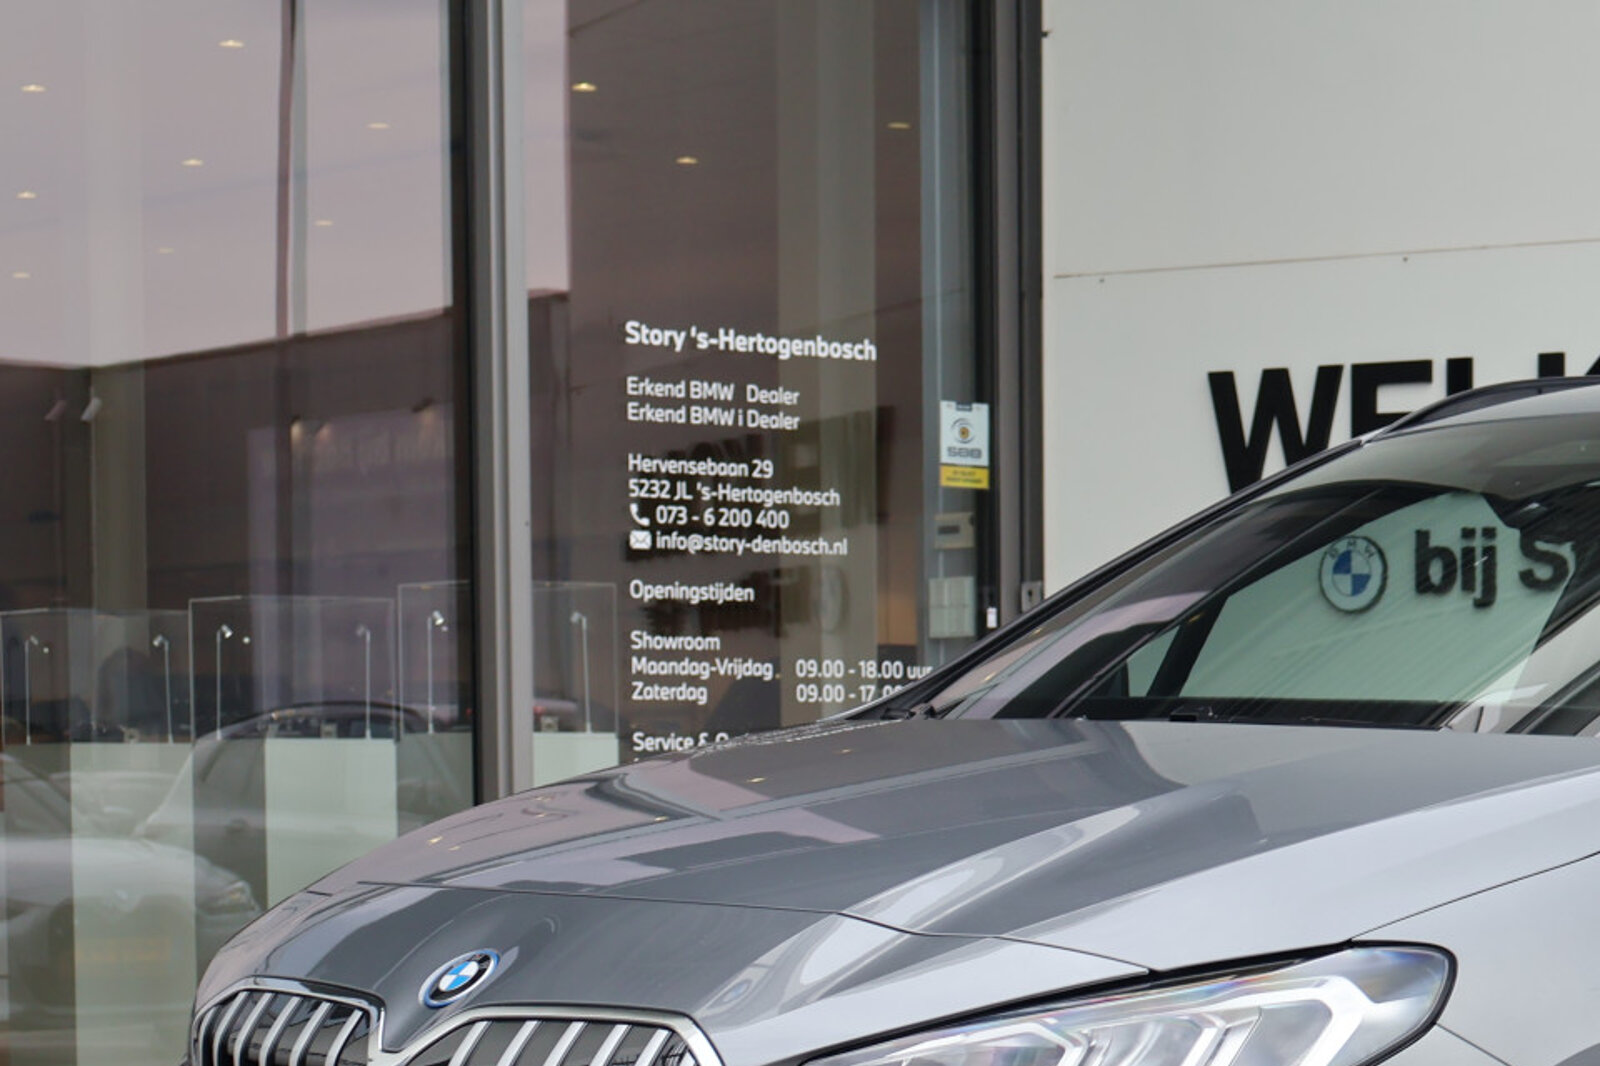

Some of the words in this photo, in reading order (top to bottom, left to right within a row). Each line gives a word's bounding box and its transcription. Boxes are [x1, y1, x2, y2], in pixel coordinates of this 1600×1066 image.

[625, 320, 686, 351] Story
[690, 325, 878, 361] 's-Hertogenbosch
[626, 376, 686, 399] Erkend
[689, 380, 735, 401] BMW
[746, 384, 800, 406] Dealer
[626, 402, 686, 425] Erkend
[689, 406, 735, 426] BMW
[746, 409, 800, 431] Dealer
[628, 453, 749, 478] Hervensebaan
[752, 458, 774, 479] 29
[628, 479, 670, 500] 5232
[674, 482, 693, 502] JL
[697, 482, 841, 507] 's-Hertogenbosch
[655, 504, 688, 526] 073
[703, 507, 715, 526] 6
[718, 508, 752, 528] 200
[756, 509, 790, 529] 400
[656, 532, 848, 556] info@story-denbosch.nl
[1414, 526, 1497, 609] bij
[629, 579, 755, 605] Openingstijden
[630, 630, 721, 651] Showroom
[631, 656, 774, 681] Maandag-Vrijdag
[795, 659, 845, 679] 09.00
[860, 660, 904, 680] 18.00
[631, 681, 708, 705] Zaterdag
[796, 683, 845, 703] 09.00
[859, 684, 905, 703] 170
[632, 731, 695, 752] Service
